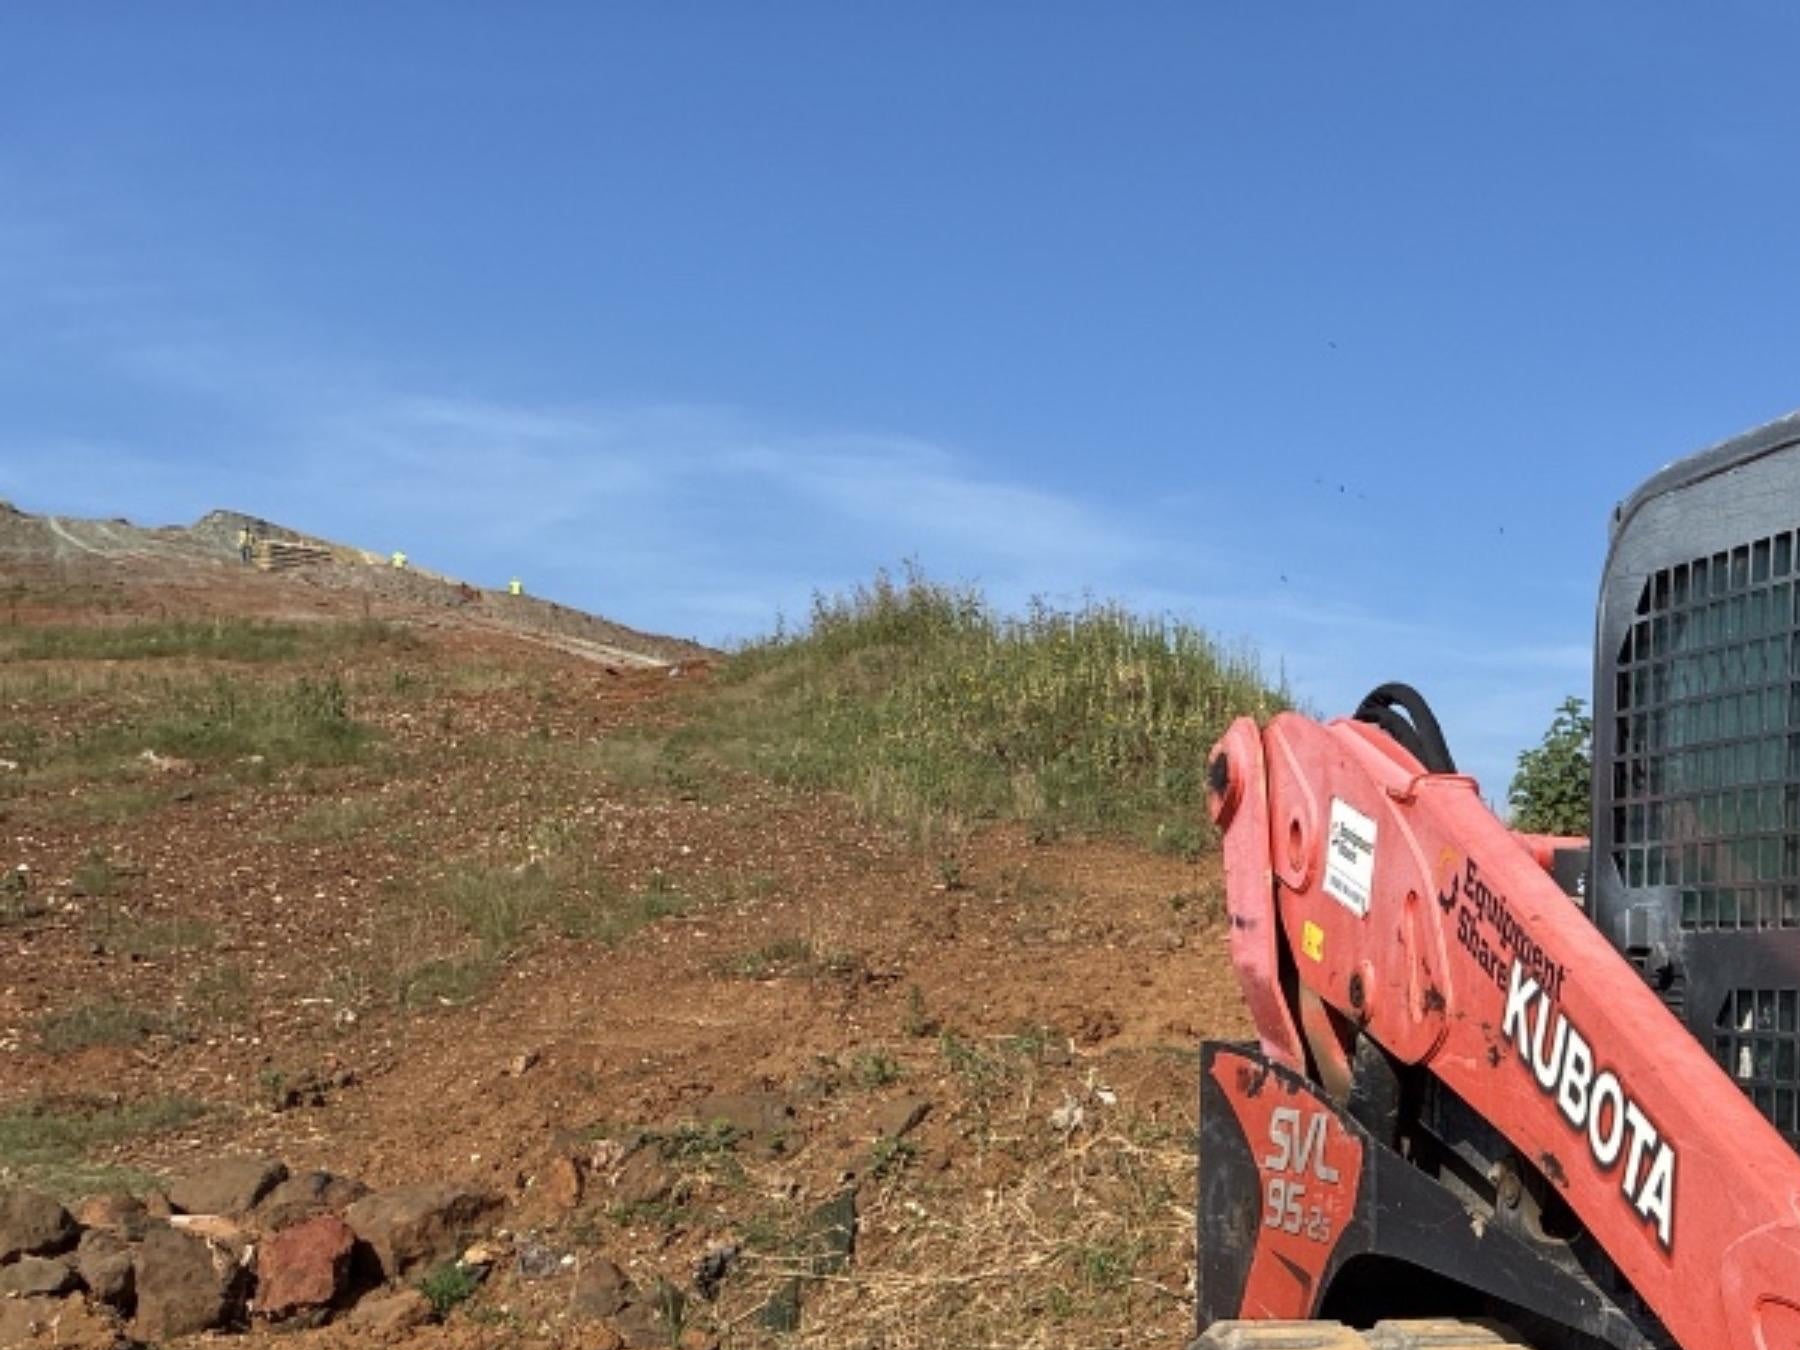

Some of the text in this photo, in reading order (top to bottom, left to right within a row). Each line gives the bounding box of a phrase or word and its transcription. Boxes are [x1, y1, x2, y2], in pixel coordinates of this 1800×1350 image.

[1457, 904, 1508, 992] Share
[1463, 855, 1566, 1003] Equipment
[1265, 1106, 1340, 1184] SVL
[1502, 957, 1676, 1249] KUBOTA
